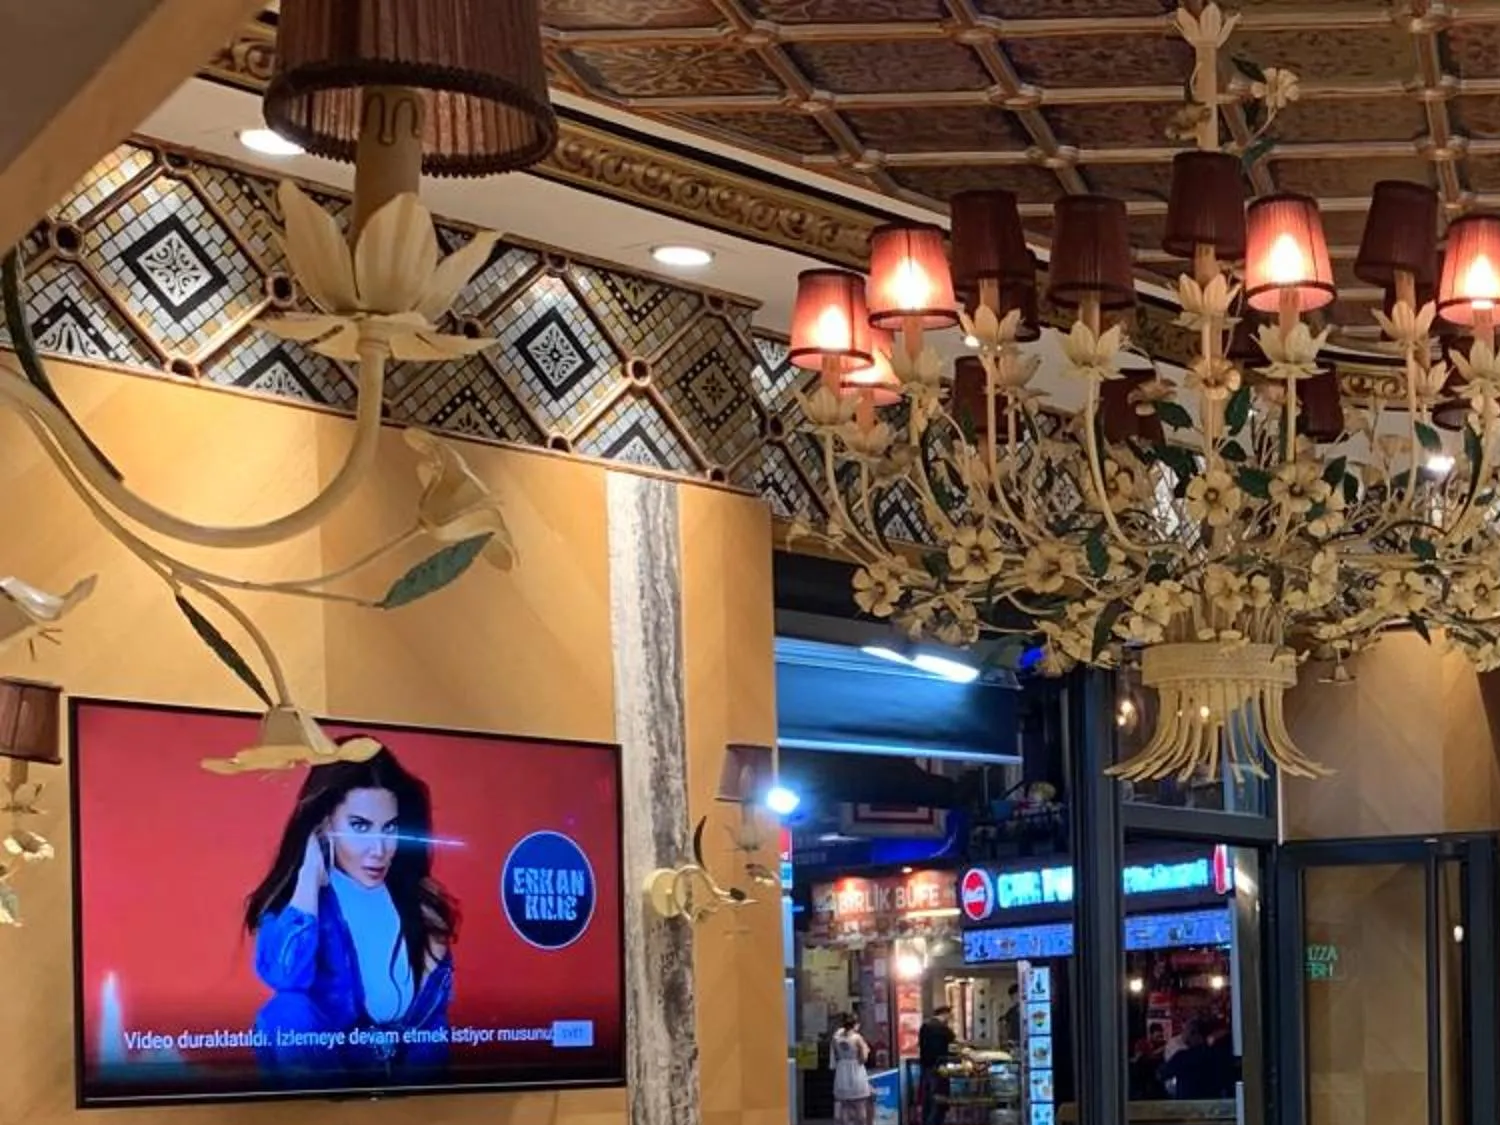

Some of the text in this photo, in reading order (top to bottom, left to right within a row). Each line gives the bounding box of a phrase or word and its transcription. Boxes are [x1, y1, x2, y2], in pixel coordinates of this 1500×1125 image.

[513, 867, 584, 896] ERKAN
[124, 1031, 173, 1049] Video
[276, 1026, 345, 1049] İzlemeye
[349, 1027, 399, 1045] devam
[402, 1026, 449, 1043] etmek
[451, 1025, 495, 1046] istiyor
